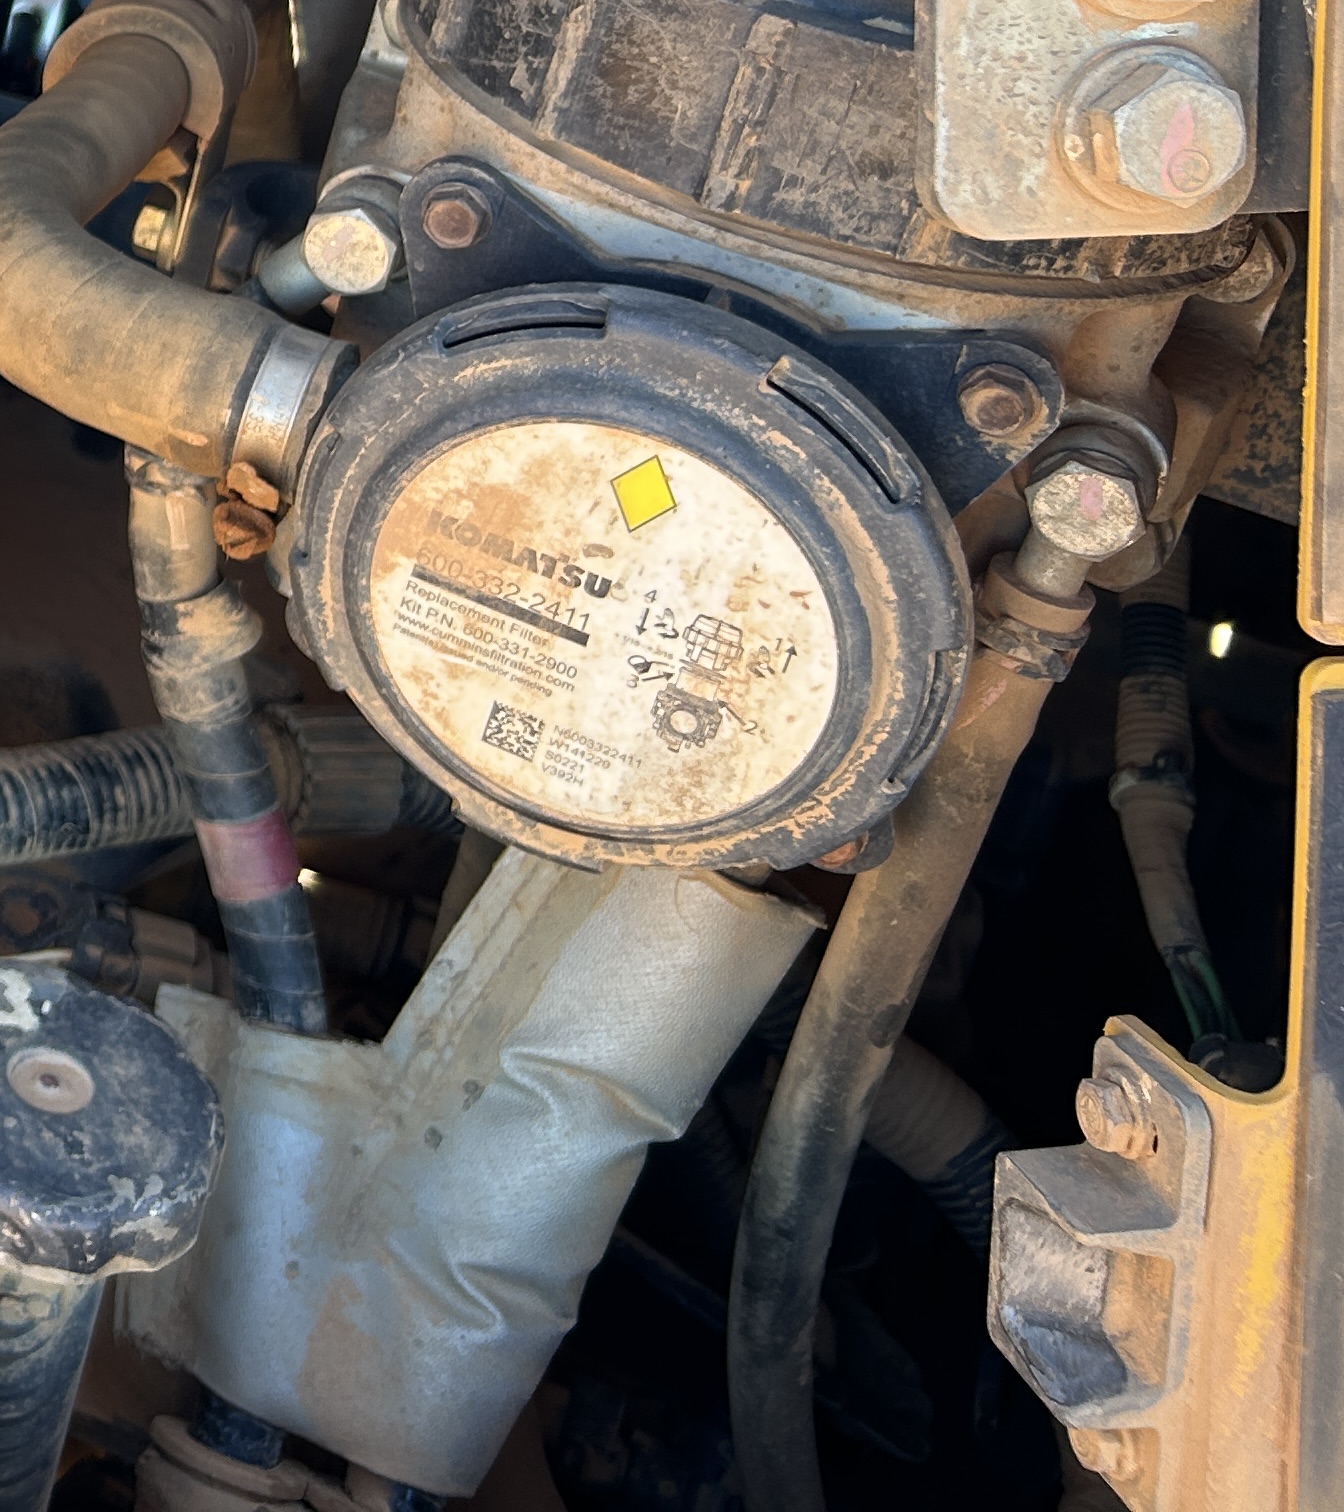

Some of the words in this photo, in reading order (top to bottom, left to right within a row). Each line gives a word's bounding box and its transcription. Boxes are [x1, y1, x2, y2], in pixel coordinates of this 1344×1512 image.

[416, 546, 590, 632] 600-332-2411
[426, 508, 613, 599] KOMATSU
[406, 579, 506, 631] Replacement
[509, 622, 549, 648] Filter
[644, 589, 657, 603] 4
[400, 596, 422, 617] Kit
[463, 622, 578, 679] 600-331-2900
[626, 674, 639, 689] 3
